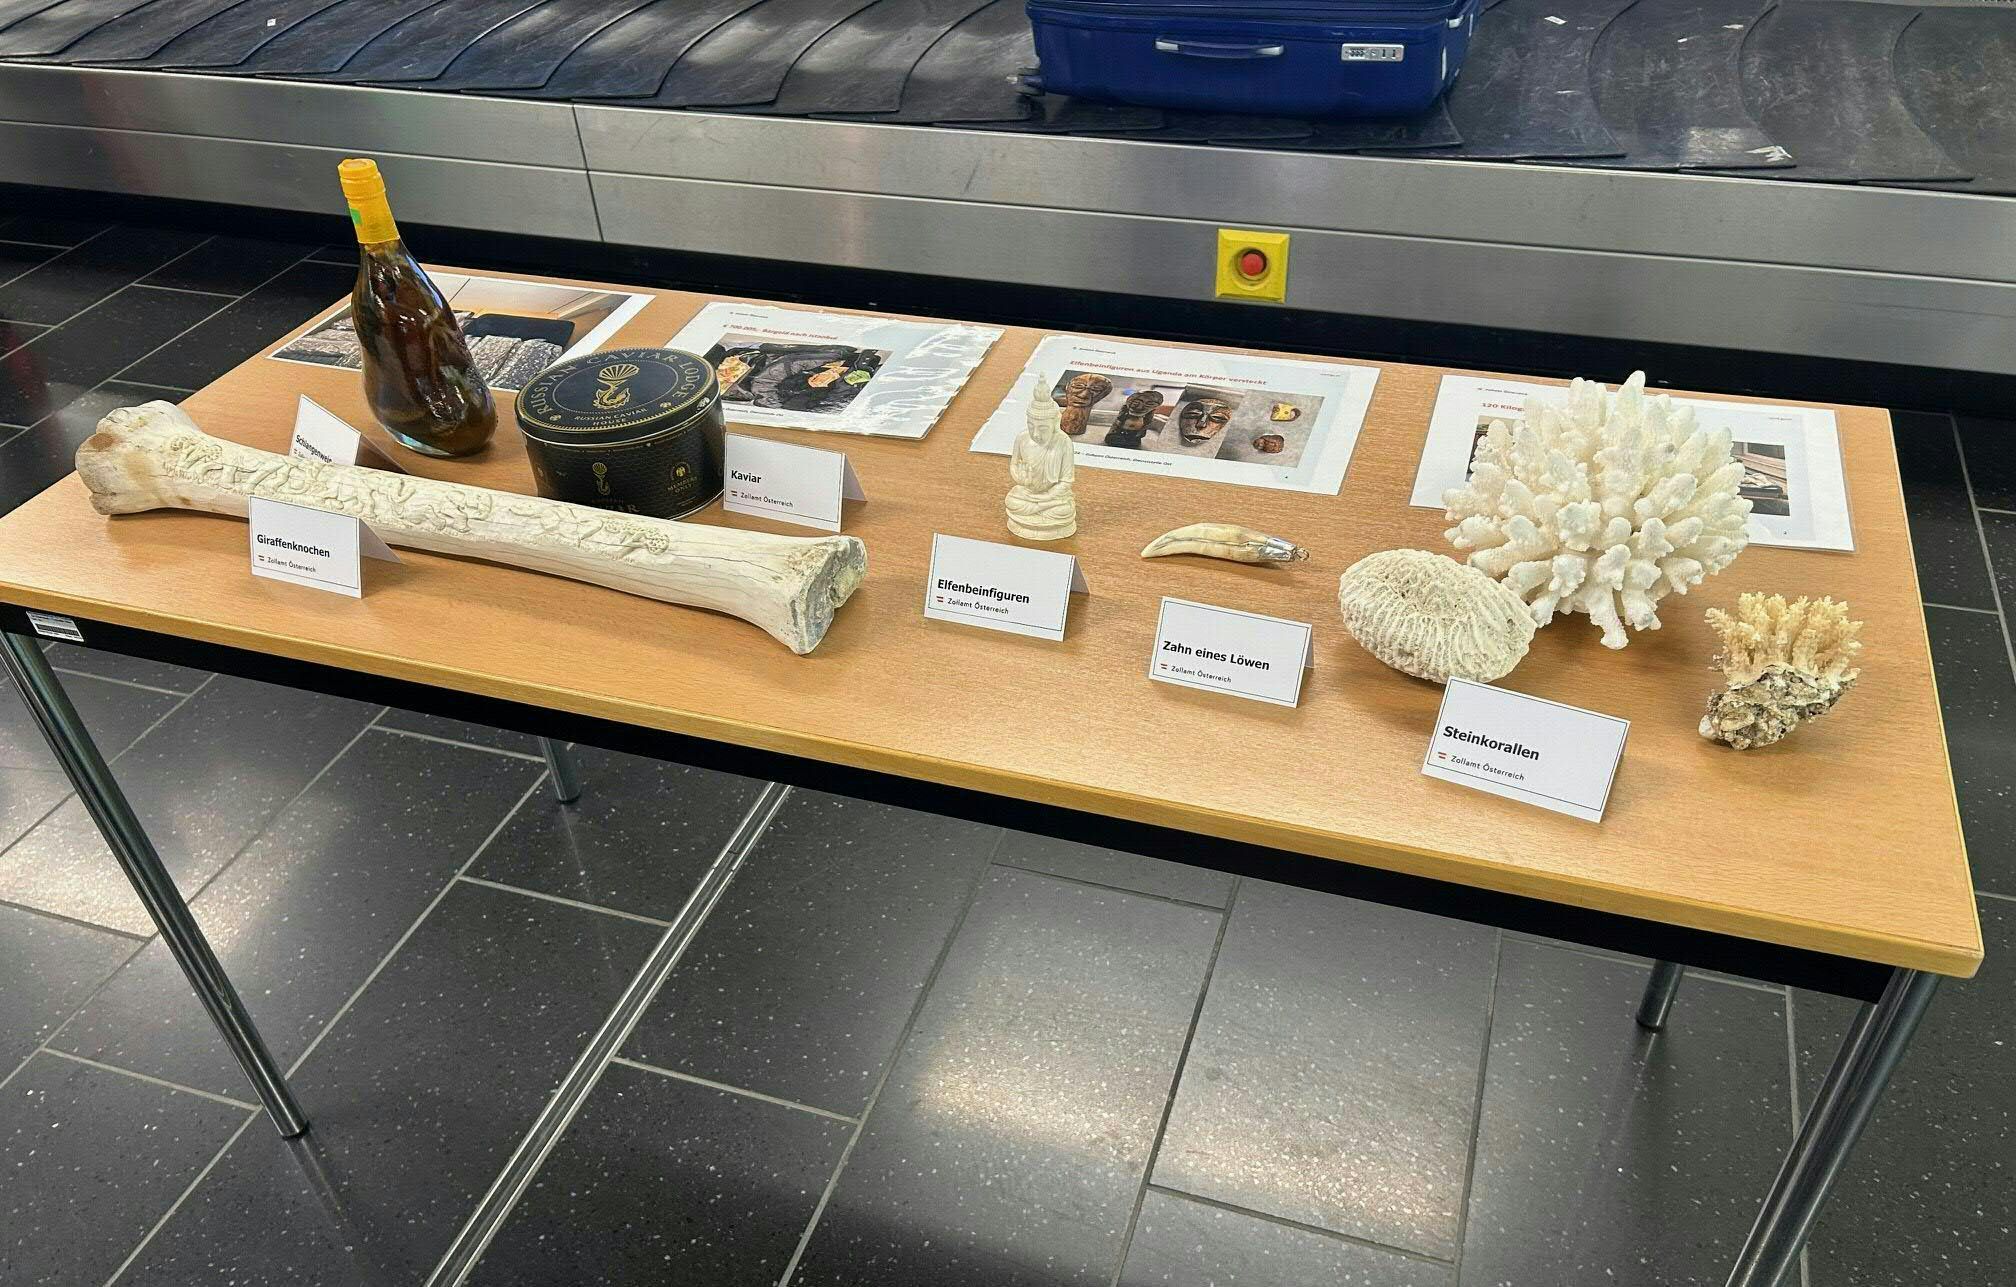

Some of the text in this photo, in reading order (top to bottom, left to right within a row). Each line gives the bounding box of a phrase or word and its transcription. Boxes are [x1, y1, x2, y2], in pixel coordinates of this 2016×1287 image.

[530, 351, 701, 415] RUSSIAN CAVIAR LODGE
[1069, 359, 1134, 373] Elfenbeinfiguren
[1152, 369, 1183, 378] Uganda
[1199, 373, 1227, 383] Körper
[1228, 376, 1268, 386] versteckt
[574, 408, 649, 422] RUSSIAN CAVIAR
[592, 417, 627, 426] HOUSE
[731, 469, 762, 484] Kaviar
[740, 491, 794, 508] Zollamt Österreich
[257, 533, 330, 558] Giraffenknochen
[267, 556, 316, 573] Zollamt Österreich
[937, 578, 1030, 604] Elfenbeinfiguren
[947, 597, 1009, 615] Zollamt Österreich
[1162, 640, 1270, 671] Zahn eines Löwen
[1171, 665, 1232, 683] Zollamt Österreich
[1443, 725, 1540, 761] Steinkorallen
[1450, 755, 1525, 781] Zollamt Österreich
